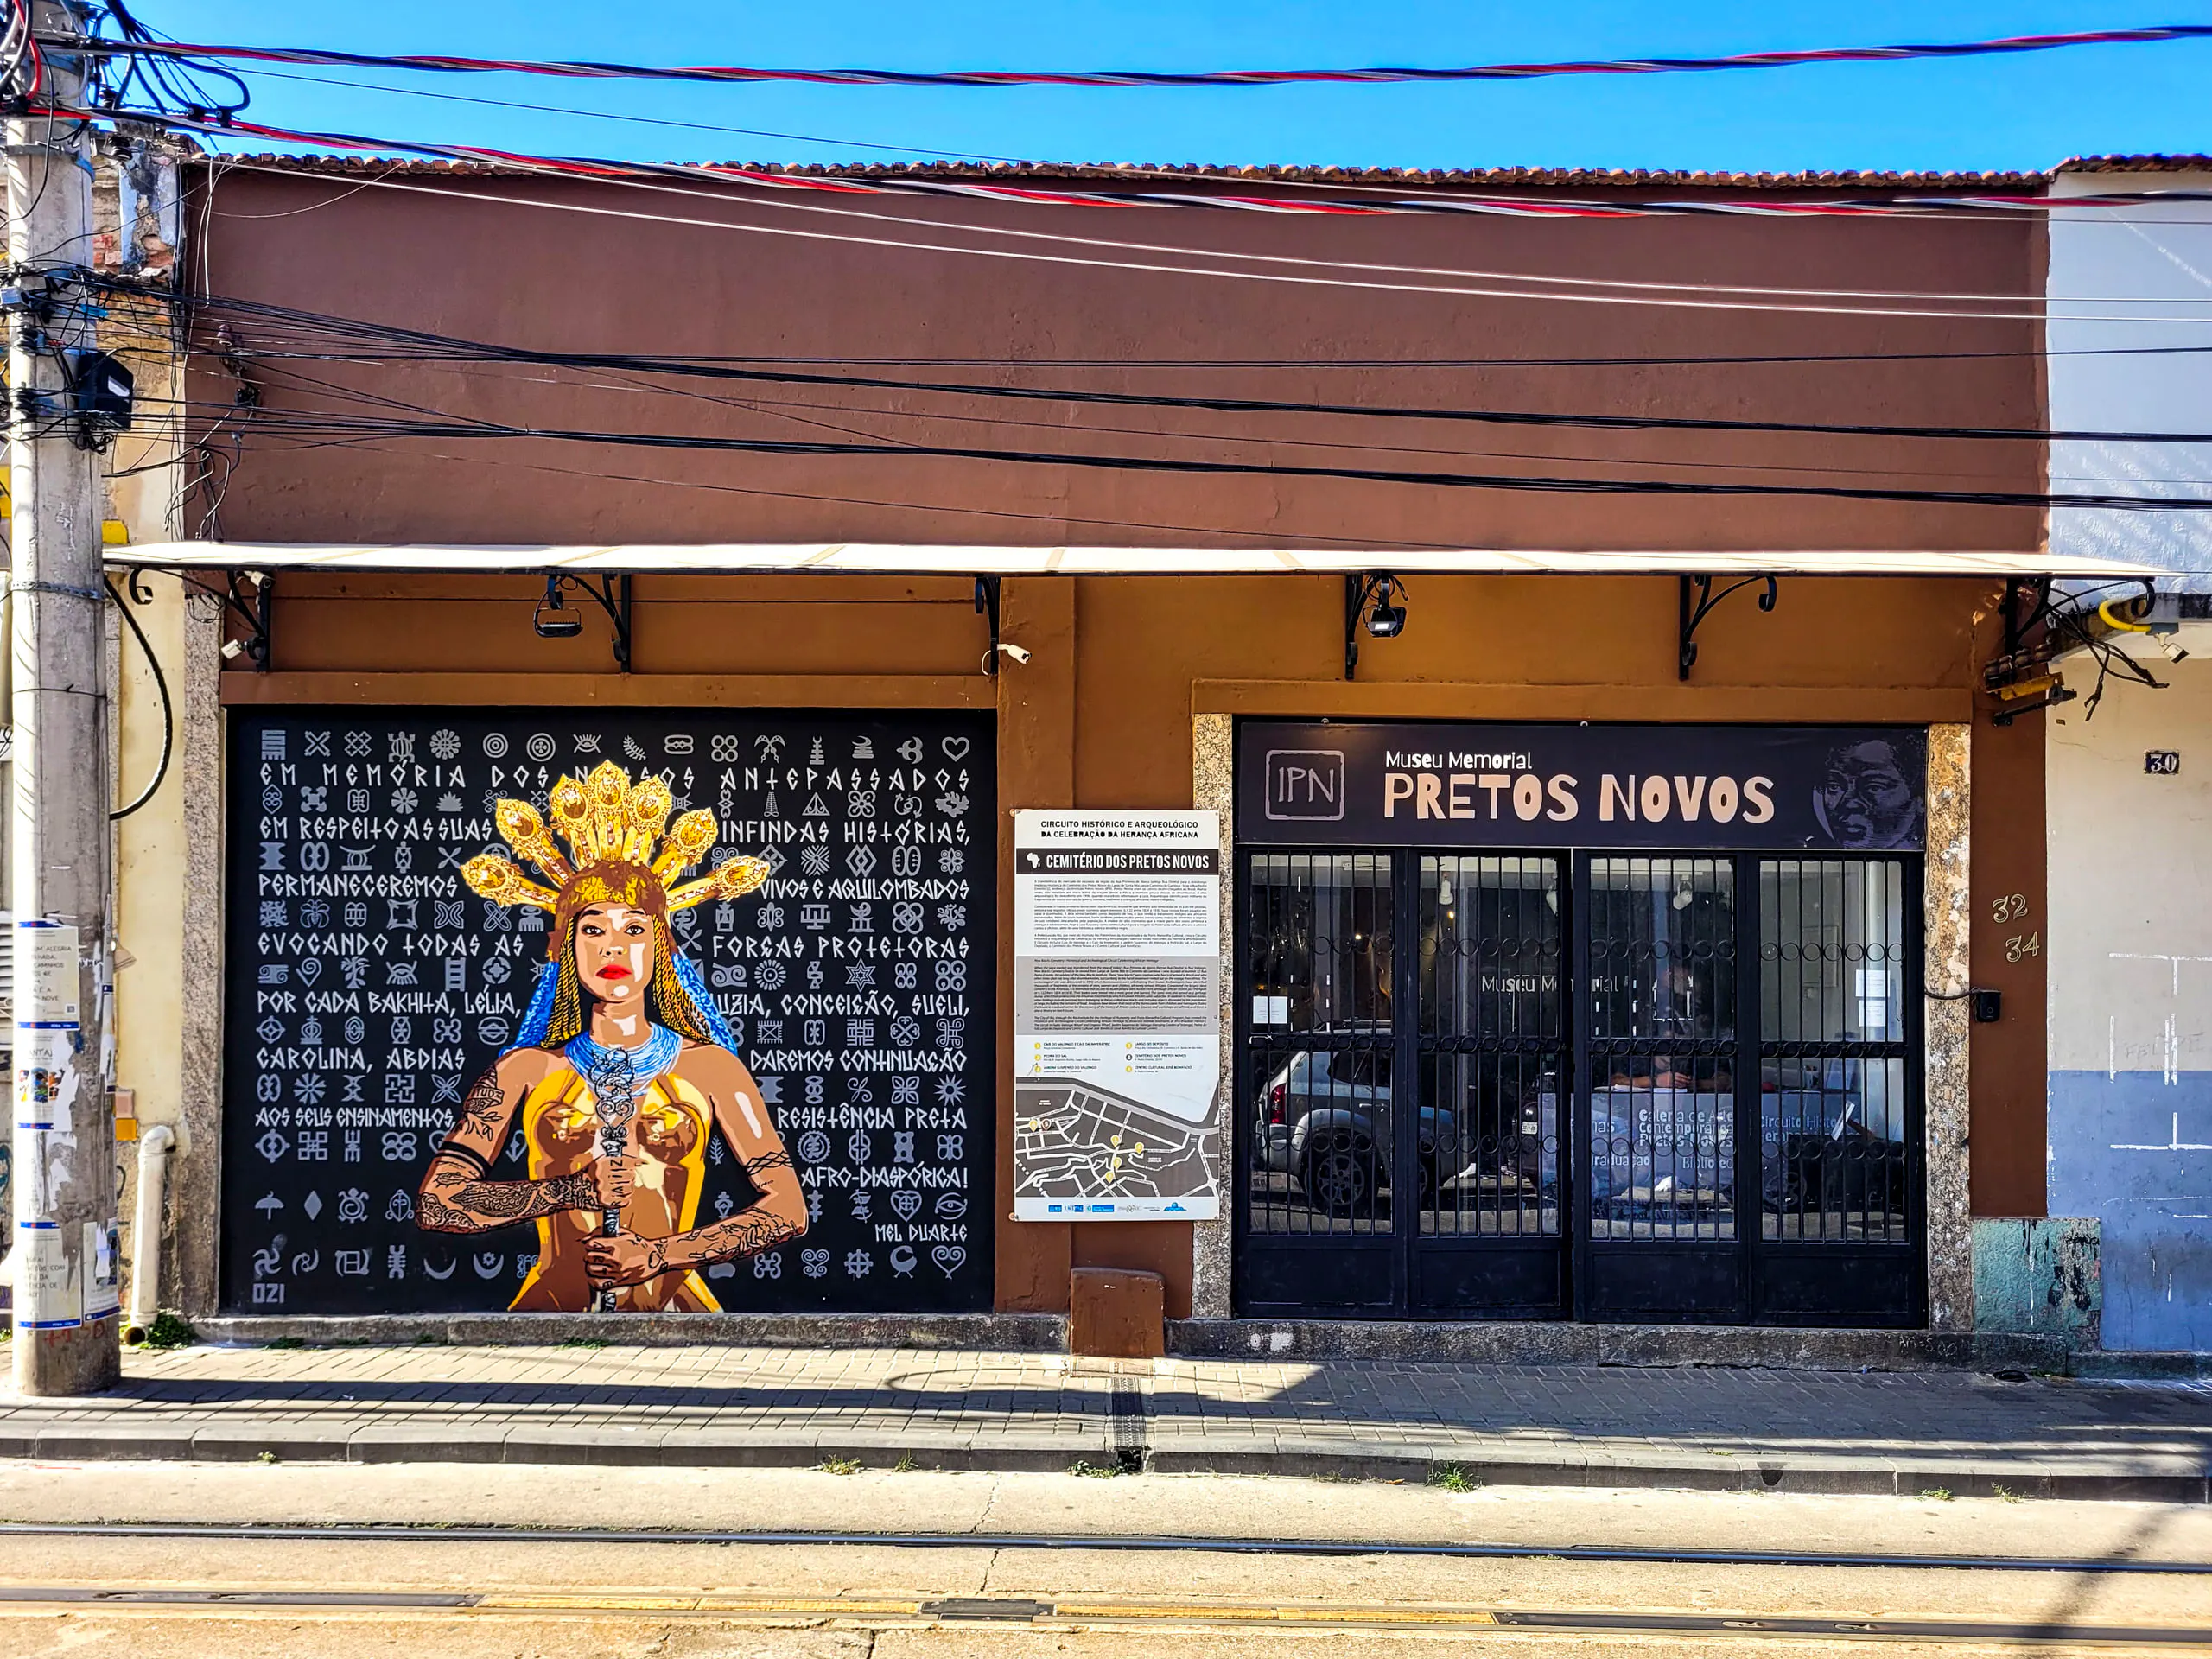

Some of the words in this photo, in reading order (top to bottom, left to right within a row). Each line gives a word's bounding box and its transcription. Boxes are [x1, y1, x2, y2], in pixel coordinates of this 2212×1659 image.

[1386, 751, 1443, 769] Museu
[1448, 751, 1533, 769] Memorial
[2150, 753, 2176, 774] 30
[259, 762, 296, 785] EM
[323, 760, 466, 788] MEMÓRIA
[491, 764, 550, 788] DOS
[575, 766, 695, 790] NSOS
[720, 767, 970, 791] ANTEPASSADOS
[1278, 766, 1334, 803] IPN
[1384, 773, 1578, 821] PRETOS
[1599, 775, 1776, 823] NOVOS
[259, 817, 288, 840] EM
[299, 817, 400, 840] RESPEITO
[403, 821, 434, 840] AS
[437, 821, 493, 840] SUAS
[722, 820, 830, 844] INFINDAS
[844, 819, 971, 845] HISTÓRIAS,
[1053, 830, 1105, 839] CELEBRAÇÃO
[1082, 819, 1125, 828] HISTÓRICO
[1135, 819, 1198, 829] ARQUEOLÓGICO
[1046, 852, 1103, 868] CEMITÉRIO
[1105, 855, 1126, 868] DOS
[1129, 855, 1171, 868] PRETOS
[1173, 855, 1209, 868] NOVOS
[258, 874, 459, 897] PERMANECEREMOS
[760, 878, 808, 900] VIVOS
[812, 878, 823, 900] E
[828, 878, 970, 900] AQUILOMBADOS
[1992, 893, 2028, 924] 32
[258, 932, 390, 956] EVOCANDO
[402, 932, 480, 956] TODAS
[494, 932, 524, 956] AS
[712, 935, 804, 959] FORÇAS
[817, 935, 970, 959] PROTETORAS
[2005, 931, 2040, 963] 34
[257, 989, 296, 1014] POR
[304, 990, 359, 1014] CADA
[369, 991, 456, 1016] BAKHITA,
[463, 983, 521, 1018] LÉLIA,
[780, 989, 899, 1016] CONCEIÇÃO,
[912, 993, 970, 1016] SUELI,
[256, 1046, 373, 1073] CAROLINA,
[387, 1046, 466, 1071] ABDIAS
[750, 1050, 834, 1071] DAREMOS
[839, 1046, 968, 1071] CONTINUAÇÃO
[255, 1107, 291, 1128] AOS
[295, 1107, 333, 1128] SEUS
[778, 1103, 895, 1129] RESISTÊNCIA
[906, 1107, 968, 1129] PRETA
[1638, 1109, 1684, 1122] Galera
[802, 1161, 968, 1189] AFRO-DIASPÓRICA!
[875, 1224, 903, 1242] MEL
[908, 1224, 968, 1243] DUARTE
